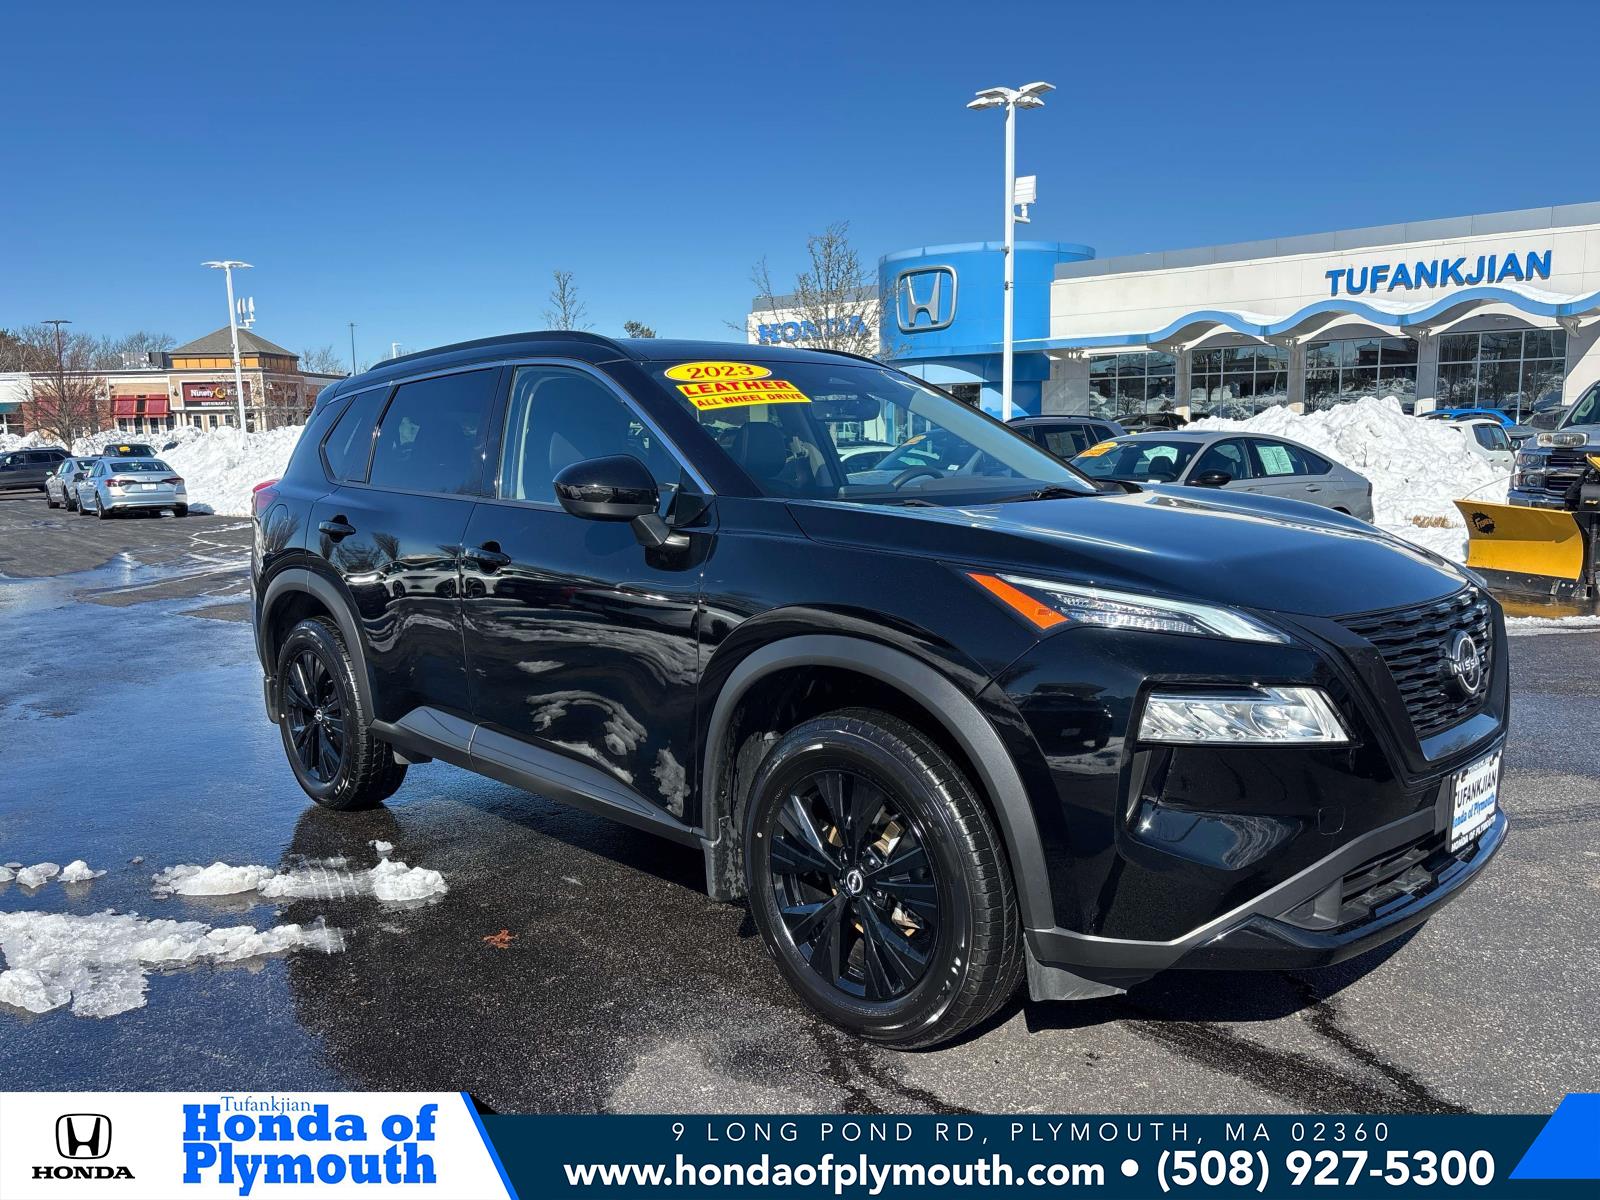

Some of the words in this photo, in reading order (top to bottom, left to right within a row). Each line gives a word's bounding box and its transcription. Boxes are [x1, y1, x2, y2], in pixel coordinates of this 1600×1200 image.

[1325, 250, 1552, 296] TUFANKJIAN
[686, 365, 754, 380] 2023
[682, 381, 790, 395] LEATHER
[697, 398, 722, 408] ALL
[722, 394, 766, 405] WHEEL
[767, 392, 804, 401] DRIVE
[1455, 768, 1497, 808] UFANKJIAN
